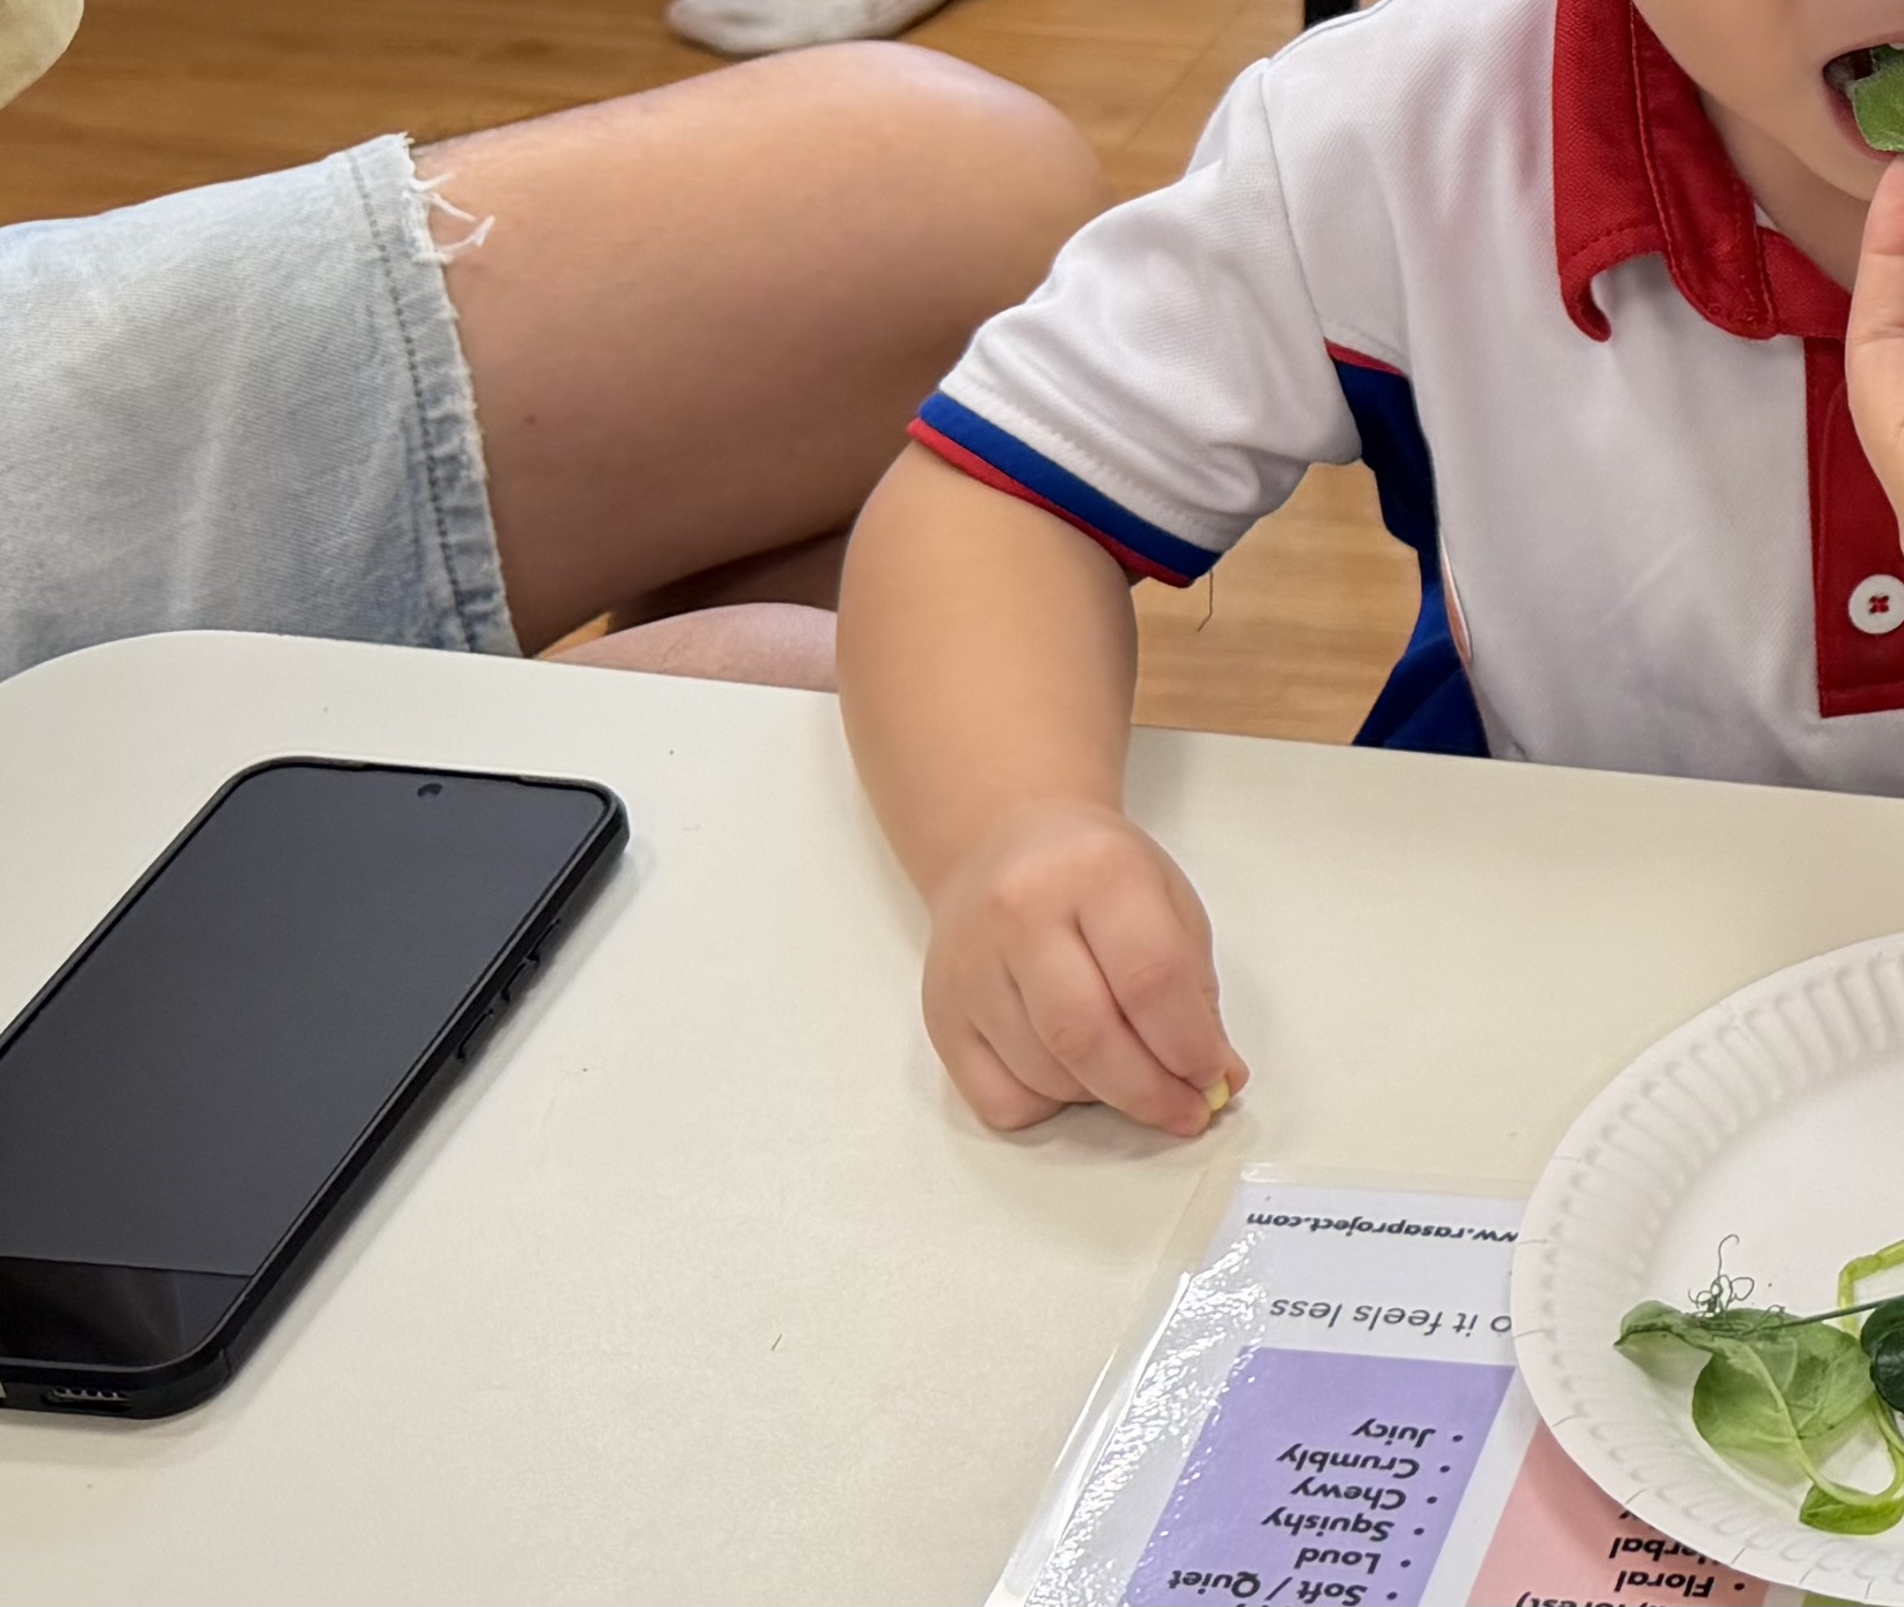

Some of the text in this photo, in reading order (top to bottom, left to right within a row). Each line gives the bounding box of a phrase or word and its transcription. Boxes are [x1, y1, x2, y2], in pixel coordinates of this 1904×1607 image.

[1247, 1213, 1519, 1243] ww.rasaproject.com
[1270, 1299, 1512, 1337] o it feels less
[1351, 1418, 1436, 1448] Juicy
[1276, 1443, 1420, 1479] Crumbly
[1290, 1477, 1406, 1510] Chewy
[1261, 1507, 1394, 1541] Squishy
[1294, 1547, 1381, 1574] Loud
[1608, 1537, 1720, 1566] erbal
[1167, 1570, 1368, 1607] Soft / Quiet
[1613, 1570, 1715, 1598] Floral
